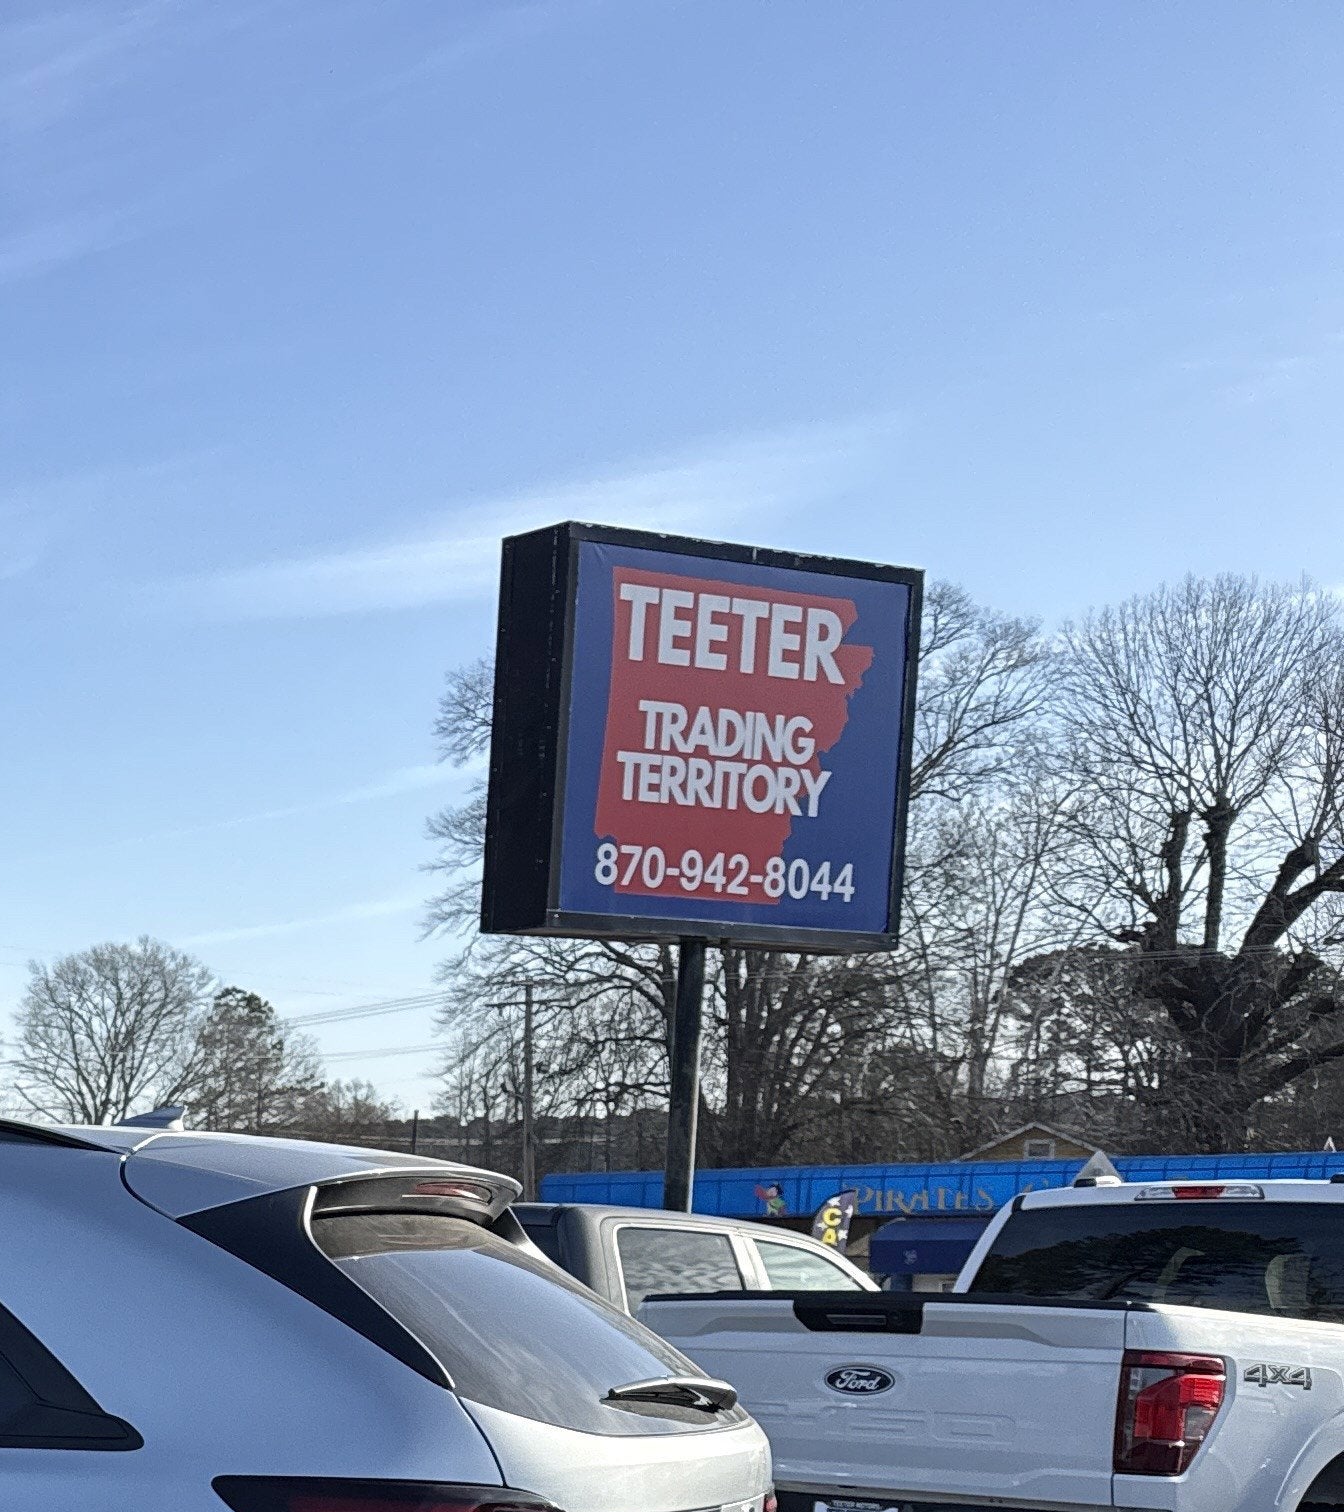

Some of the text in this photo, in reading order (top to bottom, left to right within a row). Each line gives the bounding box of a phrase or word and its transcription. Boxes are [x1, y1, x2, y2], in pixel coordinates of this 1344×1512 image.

[618, 582, 846, 686] TEETER
[638, 699, 816, 765] TRADING
[616, 751, 833, 818] TERRITORY
[594, 842, 856, 903] 870-942-8044
[834, 1369, 880, 1392] Ford
[1243, 1363, 1313, 1391] 4x4
